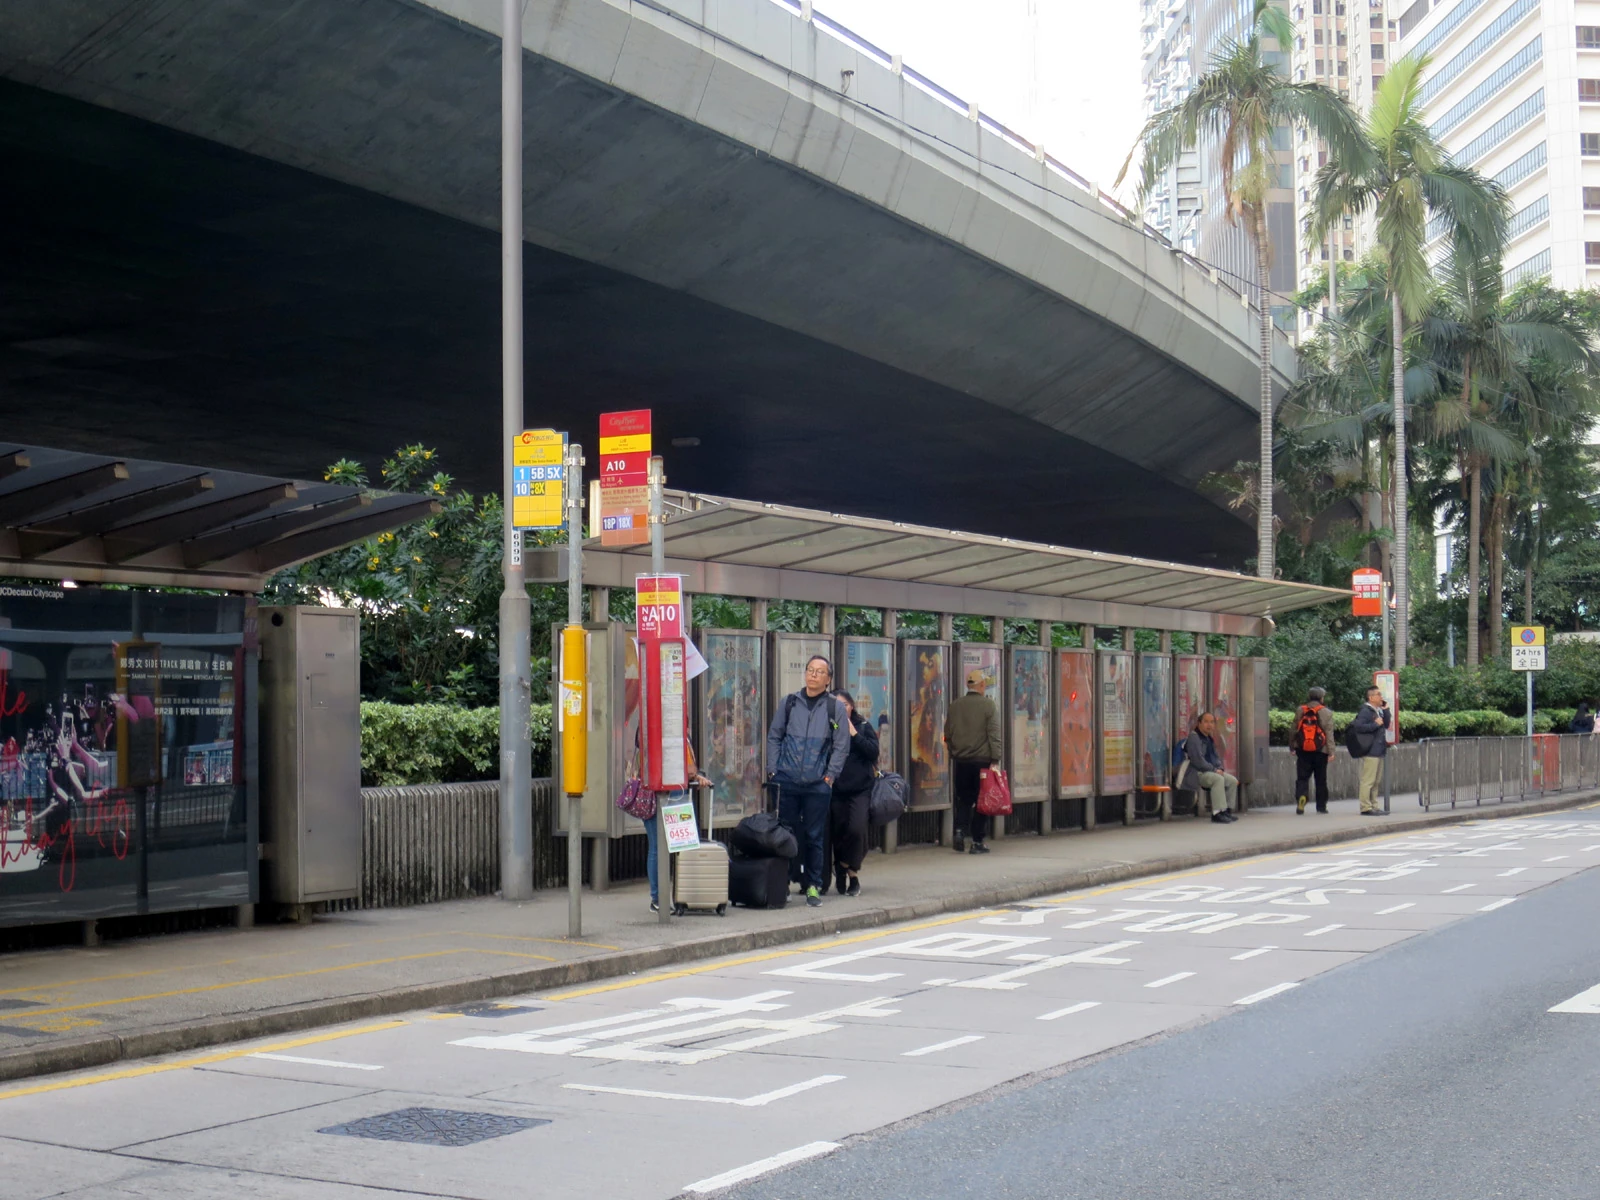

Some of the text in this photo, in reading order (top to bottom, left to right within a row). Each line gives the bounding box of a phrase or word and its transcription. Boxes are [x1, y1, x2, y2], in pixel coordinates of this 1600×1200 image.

[606, 460, 626, 471] A10
[519, 467, 561, 480] 1 5B 5X
[516, 483, 527, 495] 10
[33, 588, 65, 600] Cityscape
[144, 659, 158, 669] SIDE
[160, 659, 178, 669] TRACK
[1518, 658, 1538, 668] 全日
[1330, 842, 1526, 857] 巴士
[1241, 859, 1440, 881] 站
[1123, 885, 1366, 906] BUS
[978, 907, 1311, 934] STOP
[760, 932, 1143, 990] 巴士
[447, 990, 902, 1065] 站
